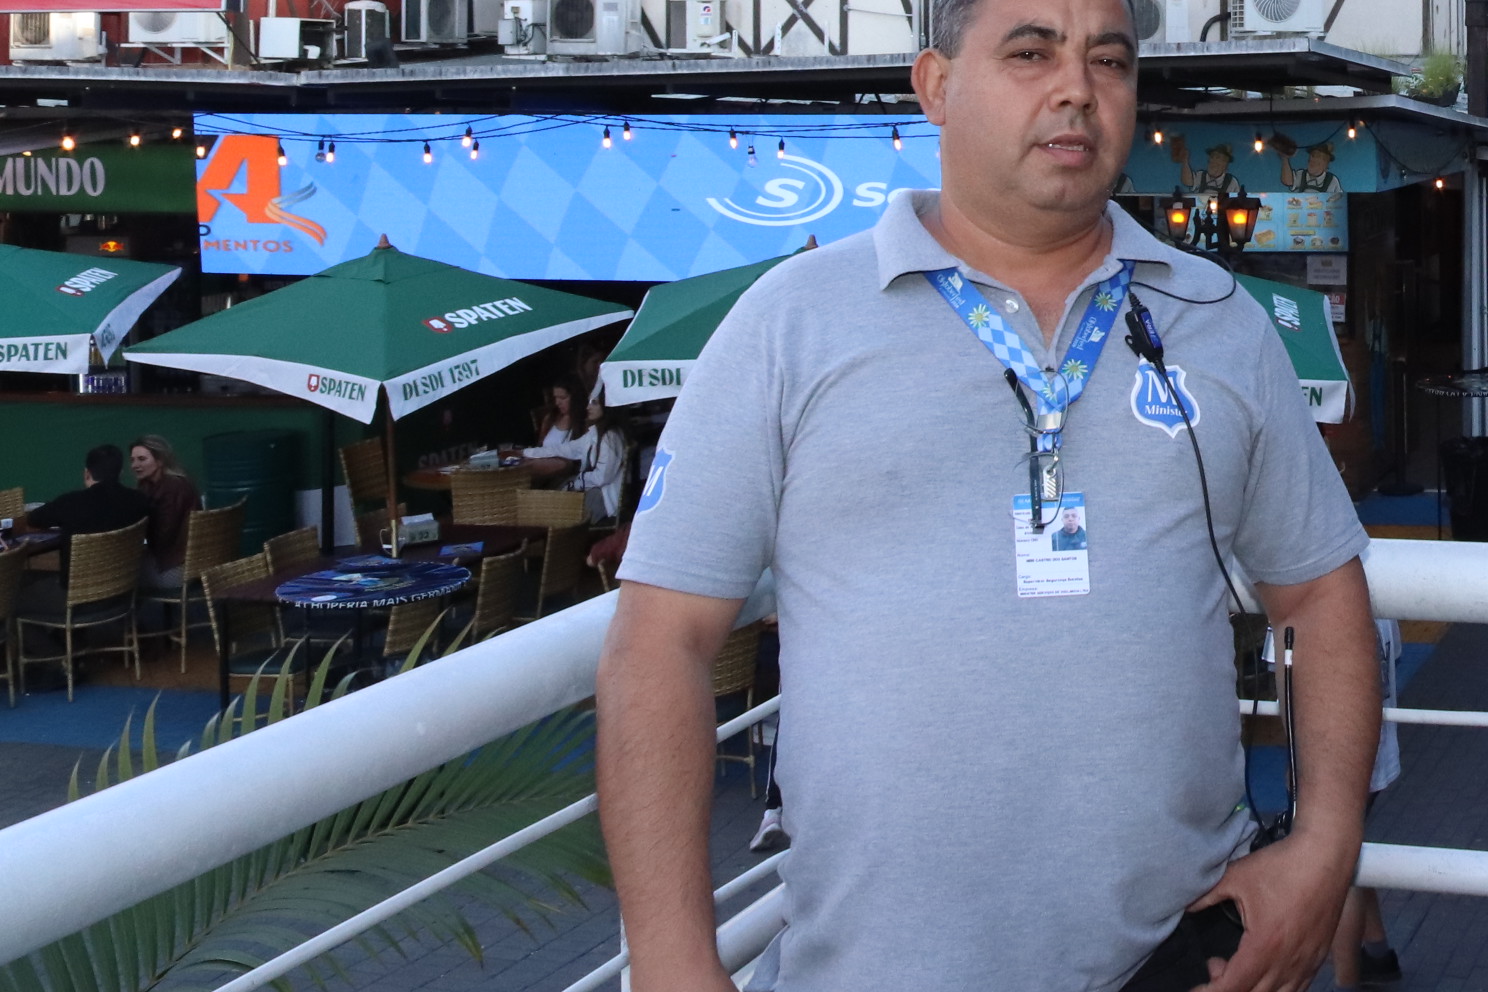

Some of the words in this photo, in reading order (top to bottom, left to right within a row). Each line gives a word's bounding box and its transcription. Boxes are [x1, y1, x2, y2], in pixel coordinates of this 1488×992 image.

[0, 157, 105, 197] MUNDO
[64, 267, 119, 292] SPATEN
[444, 297, 533, 329] SPATEN
[0, 342, 67, 362] SPATEN
[319, 378, 366, 402] SPATEN
[402, 374, 446, 401] DESDE
[450, 359, 480, 385] 1397
